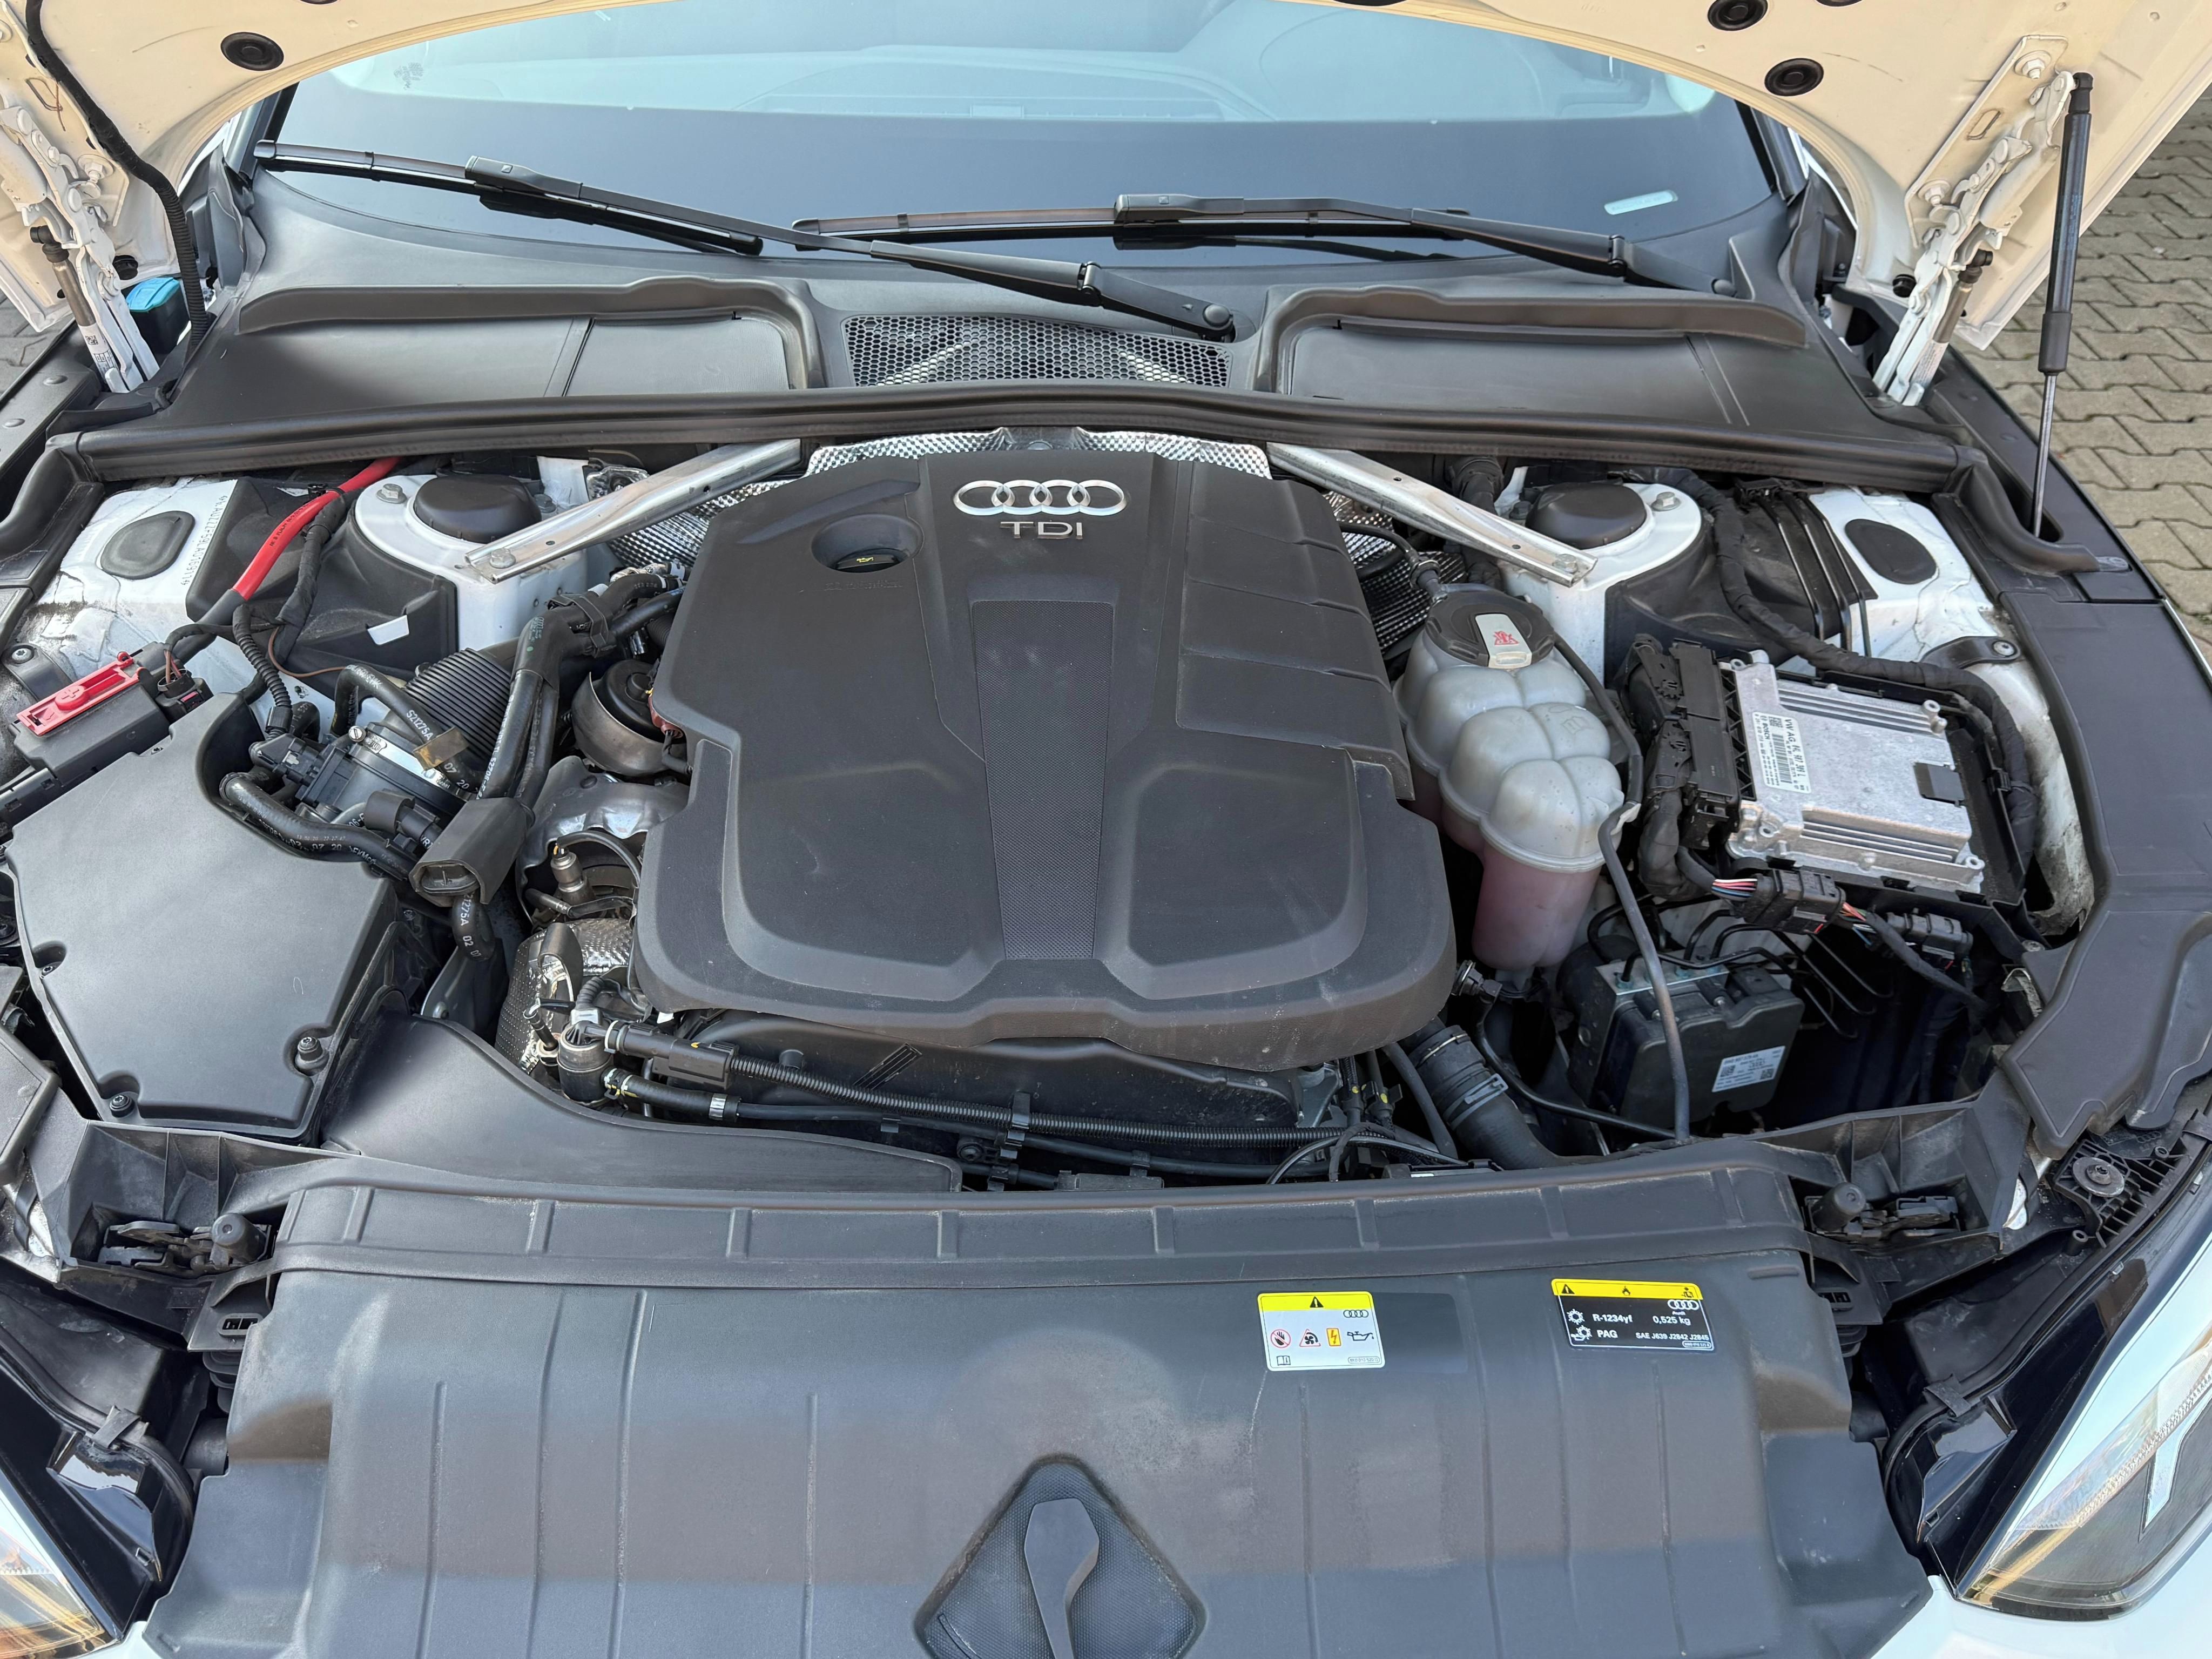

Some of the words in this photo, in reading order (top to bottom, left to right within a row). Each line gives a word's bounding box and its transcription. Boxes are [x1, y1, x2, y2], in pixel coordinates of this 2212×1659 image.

[1000, 522, 1083, 539] TDI
[1763, 723, 1771, 740] BOSCH
[1784, 719, 1794, 731] VW
[1787, 731, 1796, 742] AG
[406, 710, 433, 740] S21275A
[444, 763, 457, 773] 07
[457, 779, 470, 789] 20
[461, 891, 473, 926] 21275A
[463, 935, 474, 947] 02
[1592, 1313, 1633, 1324] R-1234yf
[1653, 1316, 1678, 1324] 0,525
[1679, 1316, 1691, 1326] kg
[1596, 1330, 1618, 1339] PAG
